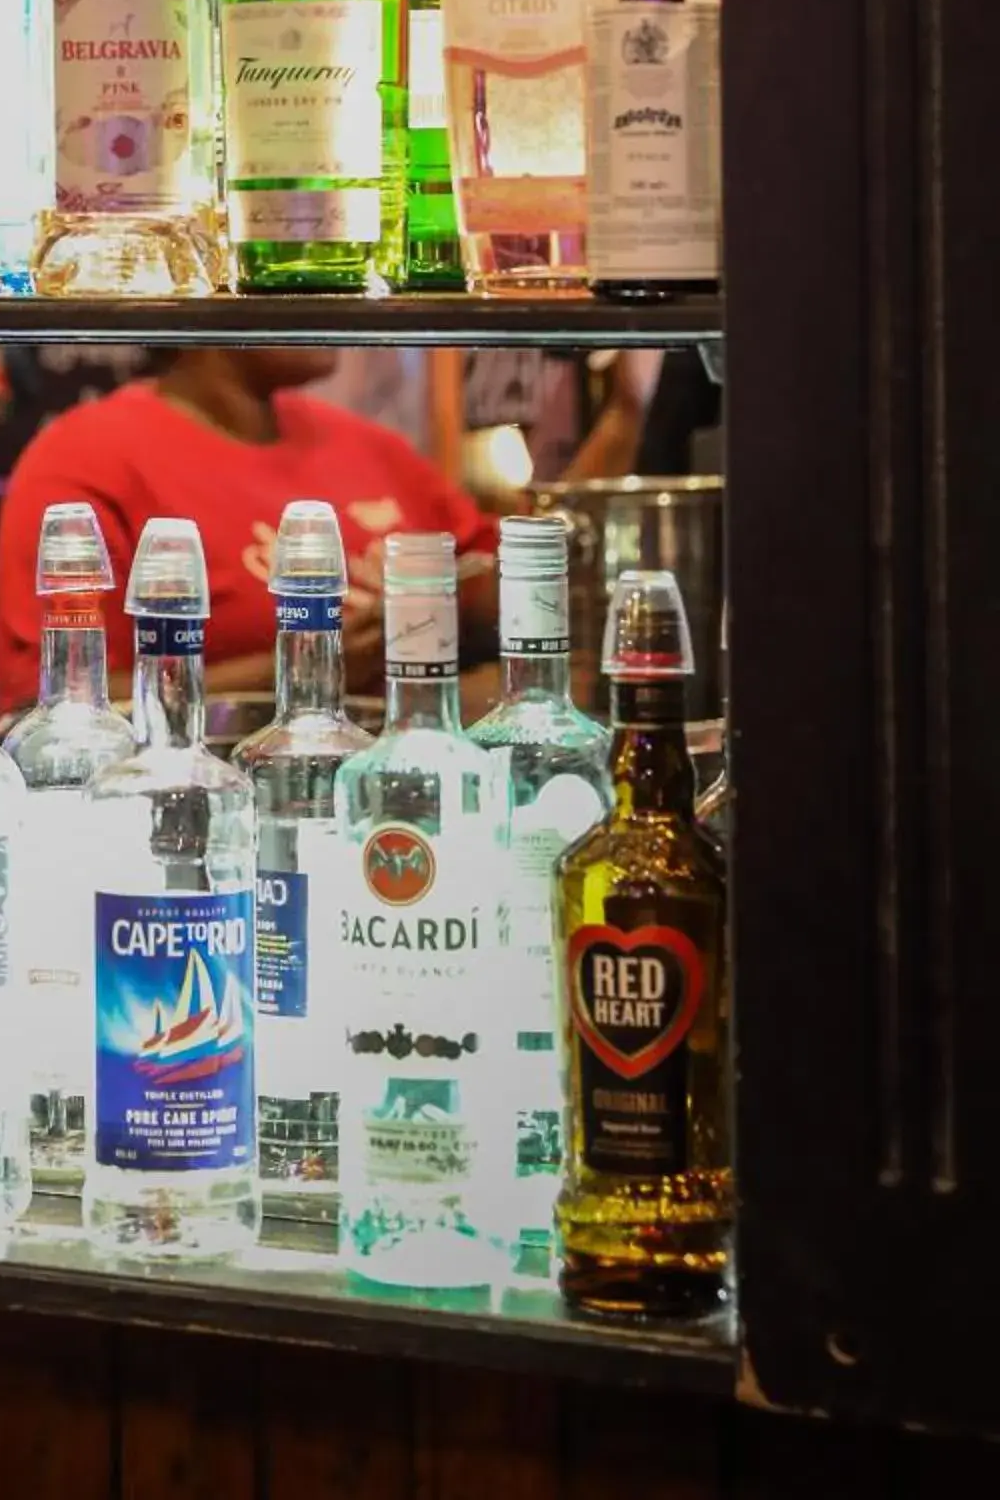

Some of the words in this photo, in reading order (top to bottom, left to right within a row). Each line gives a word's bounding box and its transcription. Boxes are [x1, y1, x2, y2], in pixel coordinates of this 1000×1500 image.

[61, 39, 182, 61] BELGRAVIA
[236, 57, 356, 89] Tanqueray
[102, 82, 141, 96] PINK
[111, 919, 185, 958] CAPE
[186, 922, 207, 942] TO
[208, 918, 246, 956] RIO
[592, 954, 666, 1001] RED
[594, 1000, 666, 1029] HEART
